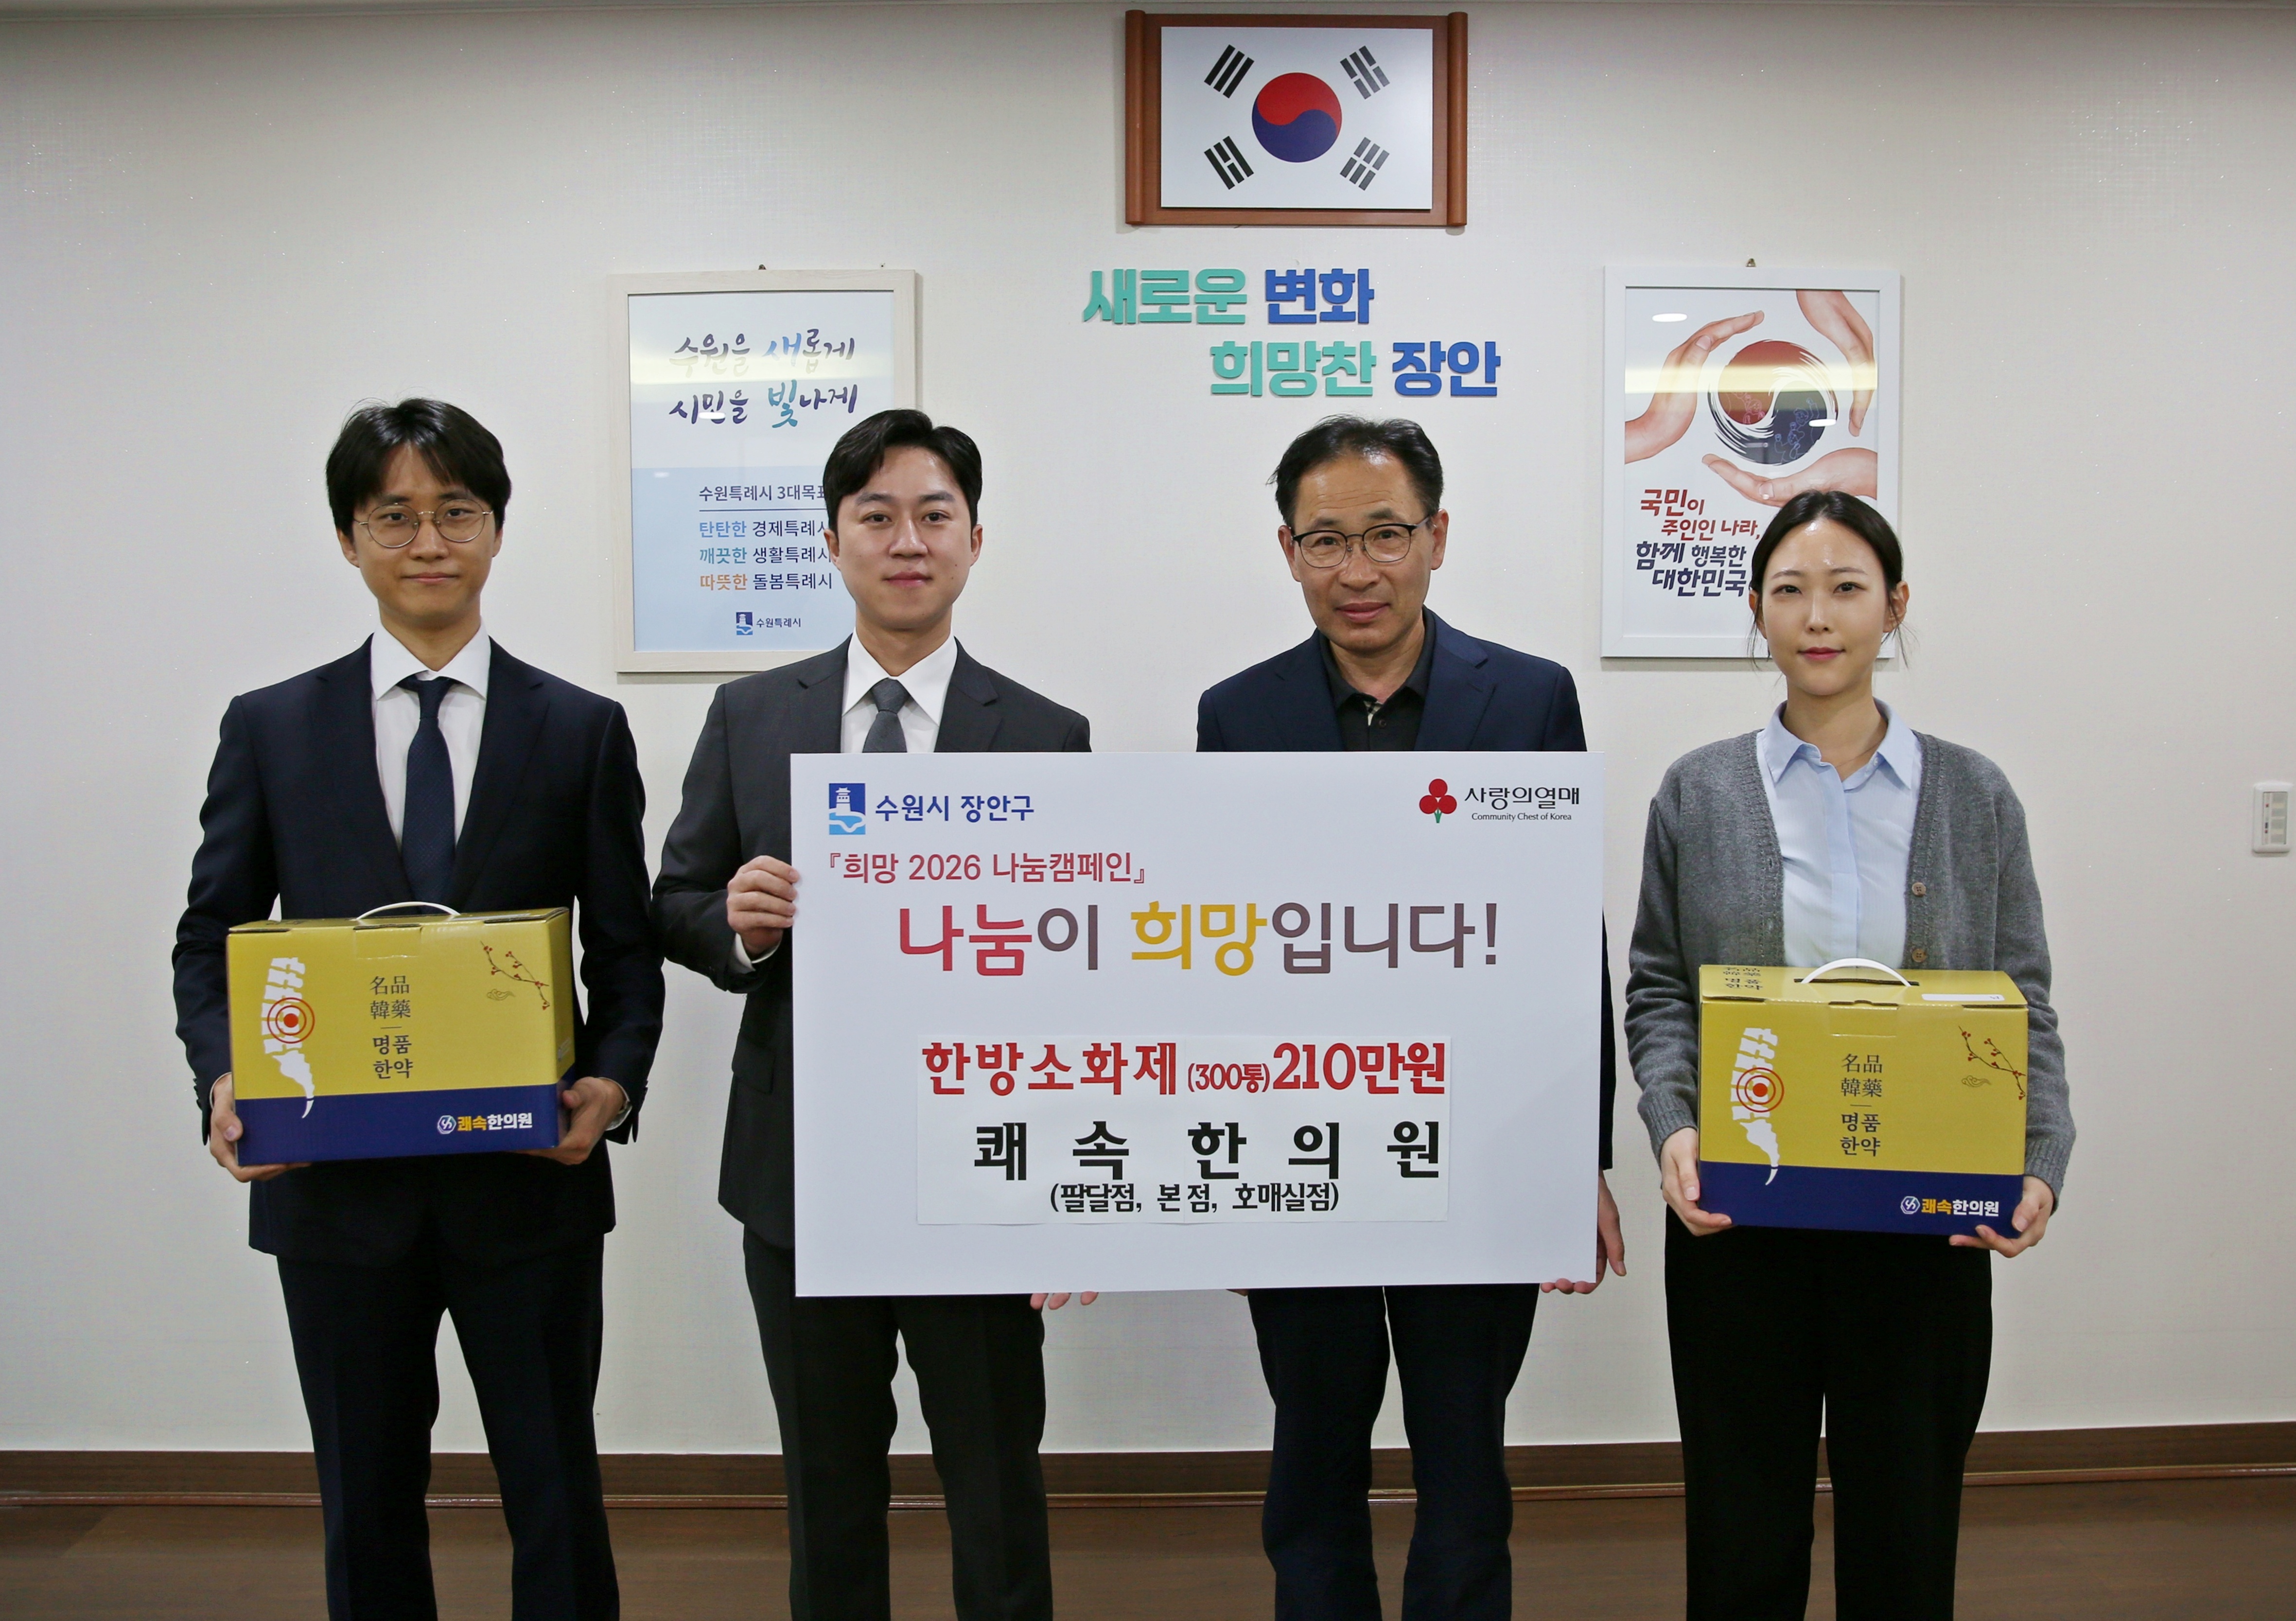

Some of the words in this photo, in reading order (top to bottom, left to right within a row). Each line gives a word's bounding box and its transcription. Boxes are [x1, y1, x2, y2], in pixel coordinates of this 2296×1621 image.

[1084, 269, 1247, 325] 새로운
[1265, 268, 1374, 325] 변화
[669, 334, 750, 378] 수원을
[762, 329, 855, 373] 새롭게
[1210, 341, 1376, 398] 희망찬
[1392, 341, 1501, 398] 장안
[669, 390, 749, 424] 시민을
[768, 379, 858, 428] 빛나게
[699, 485, 771, 501] 수원특례시
[1641, 490, 1704, 516] 국민이
[700, 521, 747, 537] 탄탄한
[1662, 520, 1716, 541] 주인인
[1721, 520, 1760, 540] 나라,
[700, 547, 747, 564] 깨끗한
[753, 547, 831, 563] 생활특례시
[1636, 541, 1686, 570] 함께
[1692, 545, 1746, 567] 행복한
[701, 574, 747, 590] 따뜻한
[753, 573, 831, 590] 돌봄특례시
[1652, 568, 1746, 597] 대한민국
[756, 618, 801, 628] 수원특례시
[876, 795, 948, 821] 수원시
[961, 796, 1034, 823] 장안구
[1465, 787, 1579, 810] 사랑의열매
[1472, 813, 1516, 822] Community
[909, 854, 981, 880] 2026
[900, 904, 1098, 976] 나눔이
[1131, 901, 1497, 976] 희망입니다!
[370, 976, 409, 995] 名品
[370, 999, 410, 1020] 韓藥
[373, 1035, 412, 1055] 명품
[373, 1058, 413, 1079] 한약
[922, 1042, 1176, 1096] 한방소화제
[1843, 1054, 1882, 1073] 名品
[1841, 1078, 1882, 1097] 韓藥
[458, 1113, 532, 1131] 쾌속한의원
[1841, 1112, 1880, 1132] 명품
[1840, 1136, 1880, 1157] 한약
[1051, 1183, 1141, 1212] (팔달점,
[1157, 1184, 1217, 1213] 본점,
[1233, 1182, 1338, 1212] 호매실점)
[1922, 1199, 1998, 1216] 쾌속한의원
